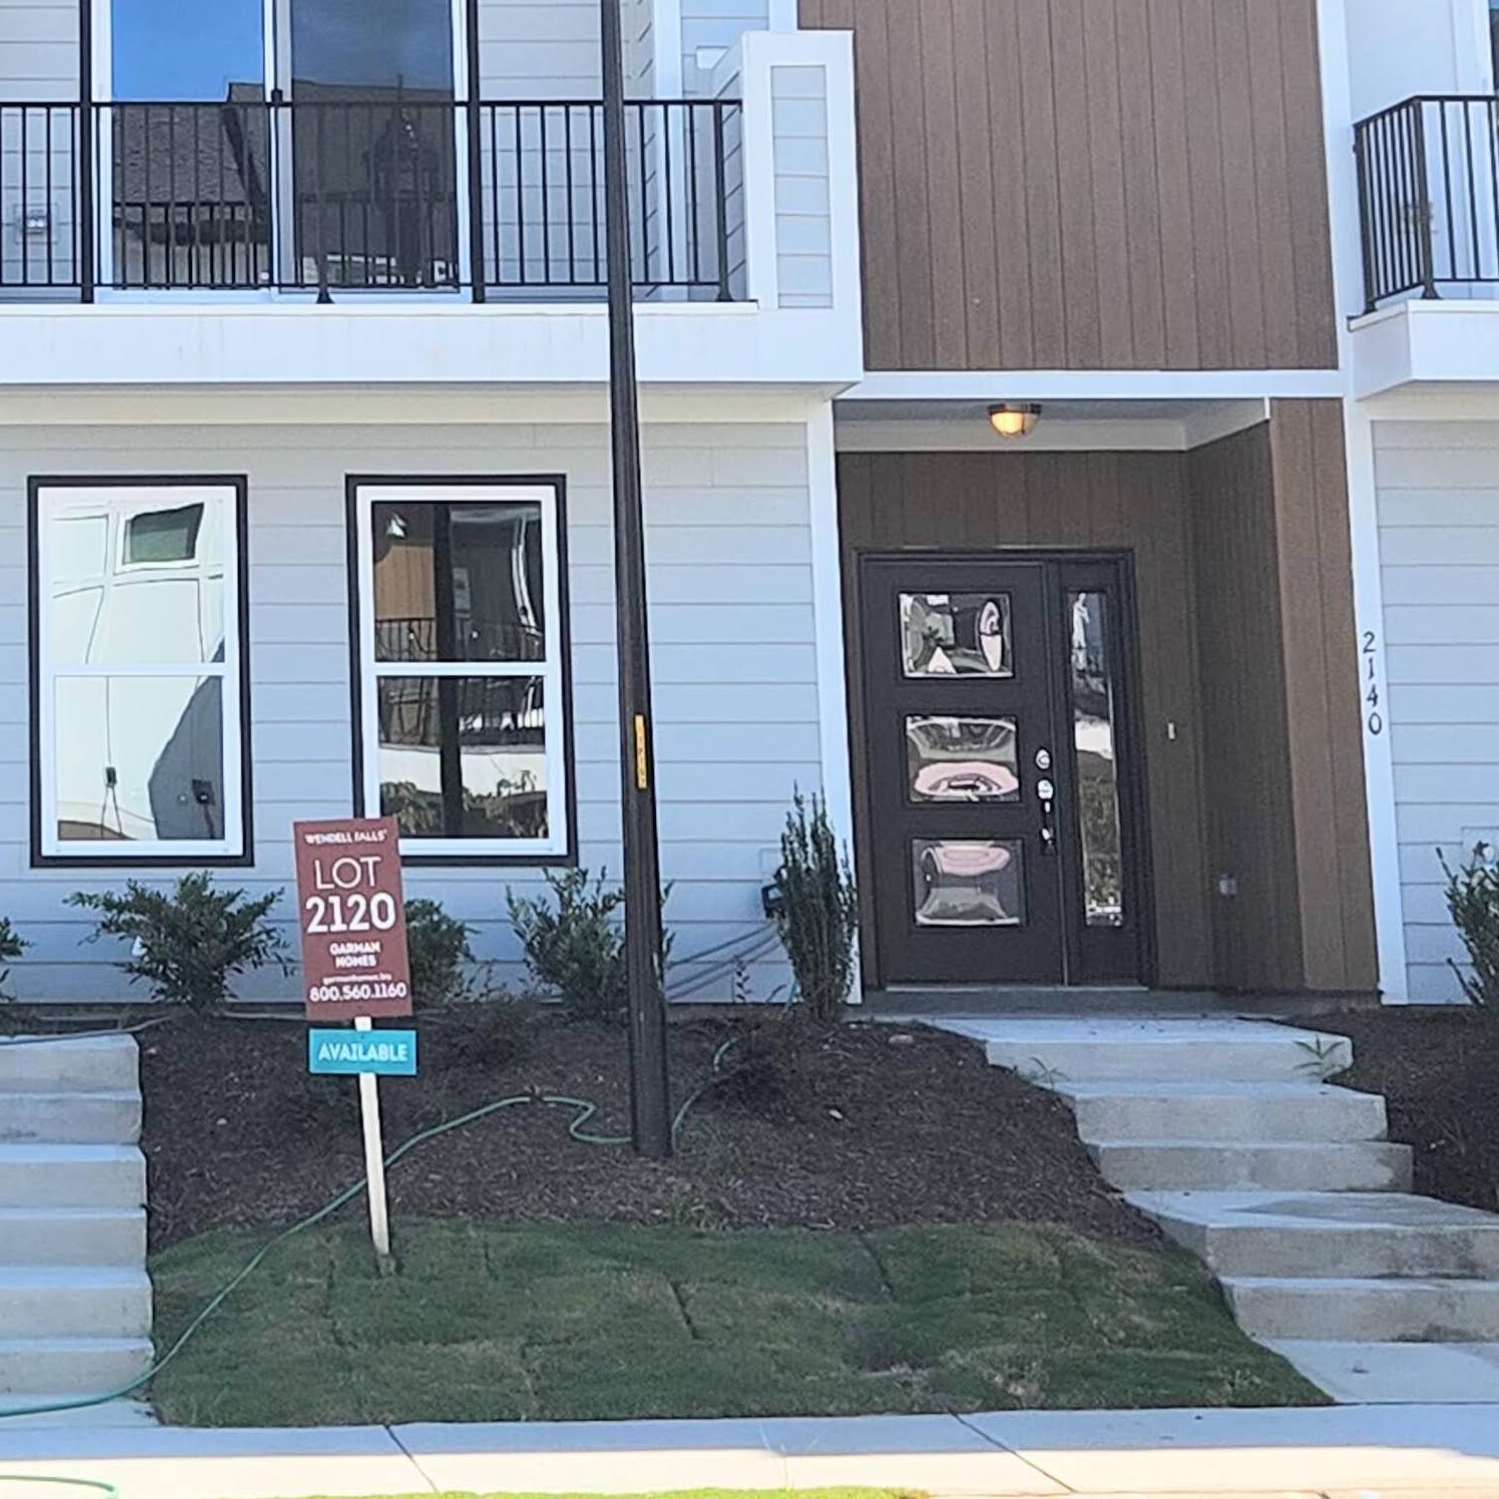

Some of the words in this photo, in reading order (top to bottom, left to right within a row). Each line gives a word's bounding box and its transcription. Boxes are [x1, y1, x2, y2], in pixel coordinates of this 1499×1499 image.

[1362, 630, 1382, 736] 2140
[304, 831, 353, 845] WENDELL
[314, 856, 382, 890] LOT
[305, 891, 396, 934] 2120
[329, 941, 381, 956] GARMAN
[335, 954, 377, 969] HOMES
[309, 982, 407, 1002] 800.560.1160
[318, 1042, 408, 1062] AVAILABLE
